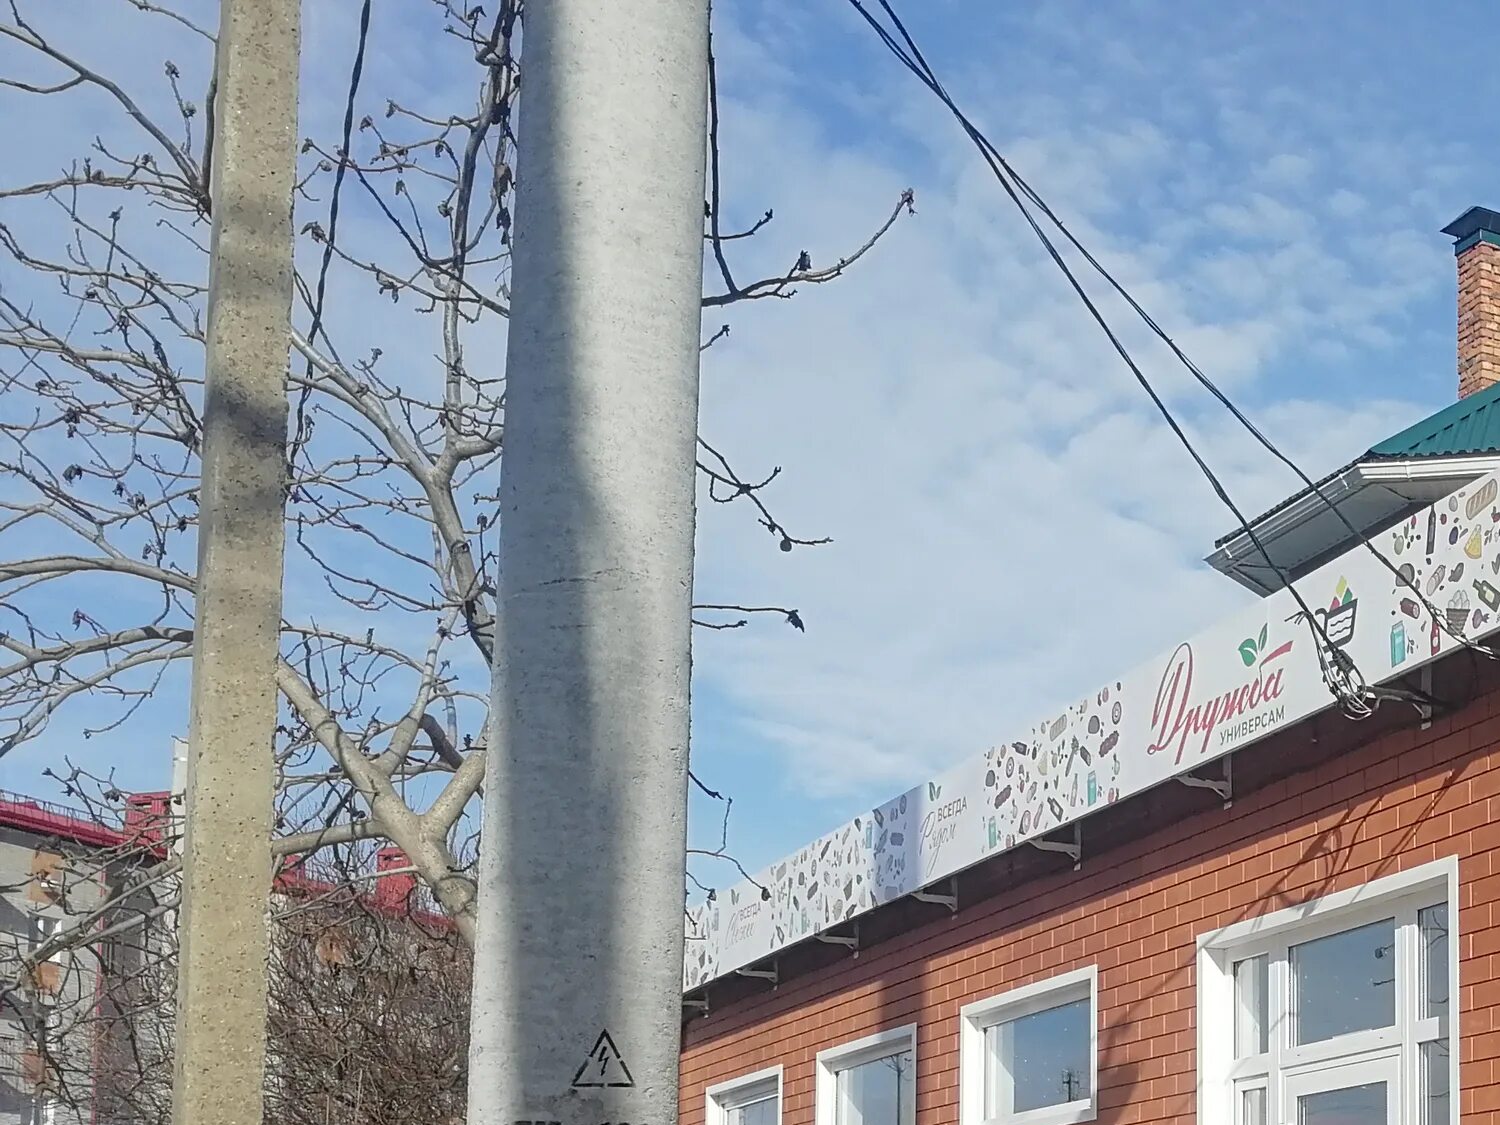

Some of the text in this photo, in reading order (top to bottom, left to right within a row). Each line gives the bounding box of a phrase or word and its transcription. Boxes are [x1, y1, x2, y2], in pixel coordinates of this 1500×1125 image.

[1147, 640, 1294, 765] Дружба
[1220, 704, 1285, 746] УНИВЕРСАМ
[938, 796, 967, 822] ВСЕГДА
